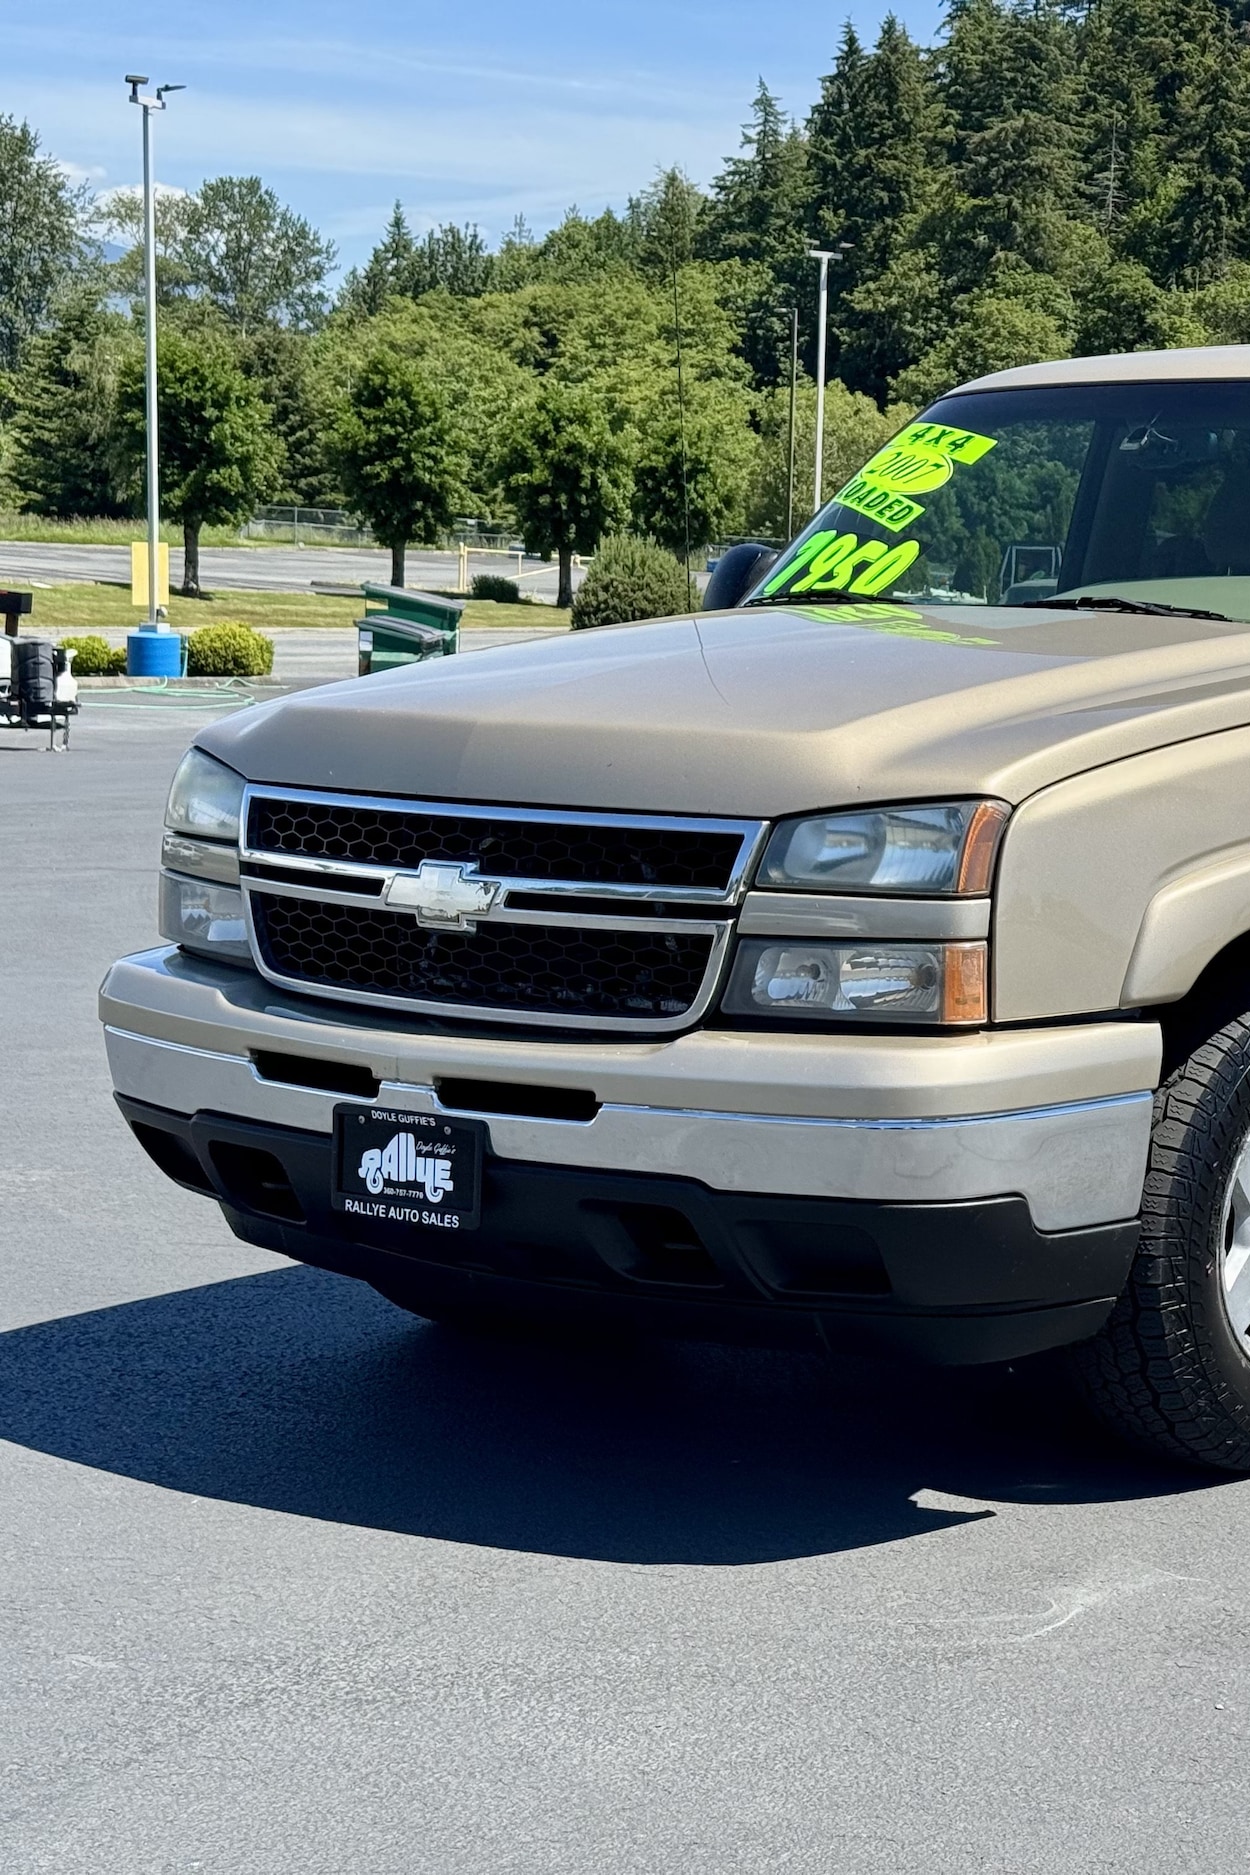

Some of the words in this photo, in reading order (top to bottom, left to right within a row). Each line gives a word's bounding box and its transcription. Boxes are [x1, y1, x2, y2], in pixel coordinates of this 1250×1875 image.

[909, 425, 974, 452] 4X4
[868, 451, 945, 484] 2007
[837, 479, 914, 524] LOADED
[763, 529, 920, 596] 7950
[371, 1110, 397, 1123] DOYLE
[398, 1114, 436, 1127] GUFFIE'S
[345, 1199, 387, 1218] RALLYE
[388, 1206, 420, 1222] AUTO
[421, 1211, 460, 1228] SALES
